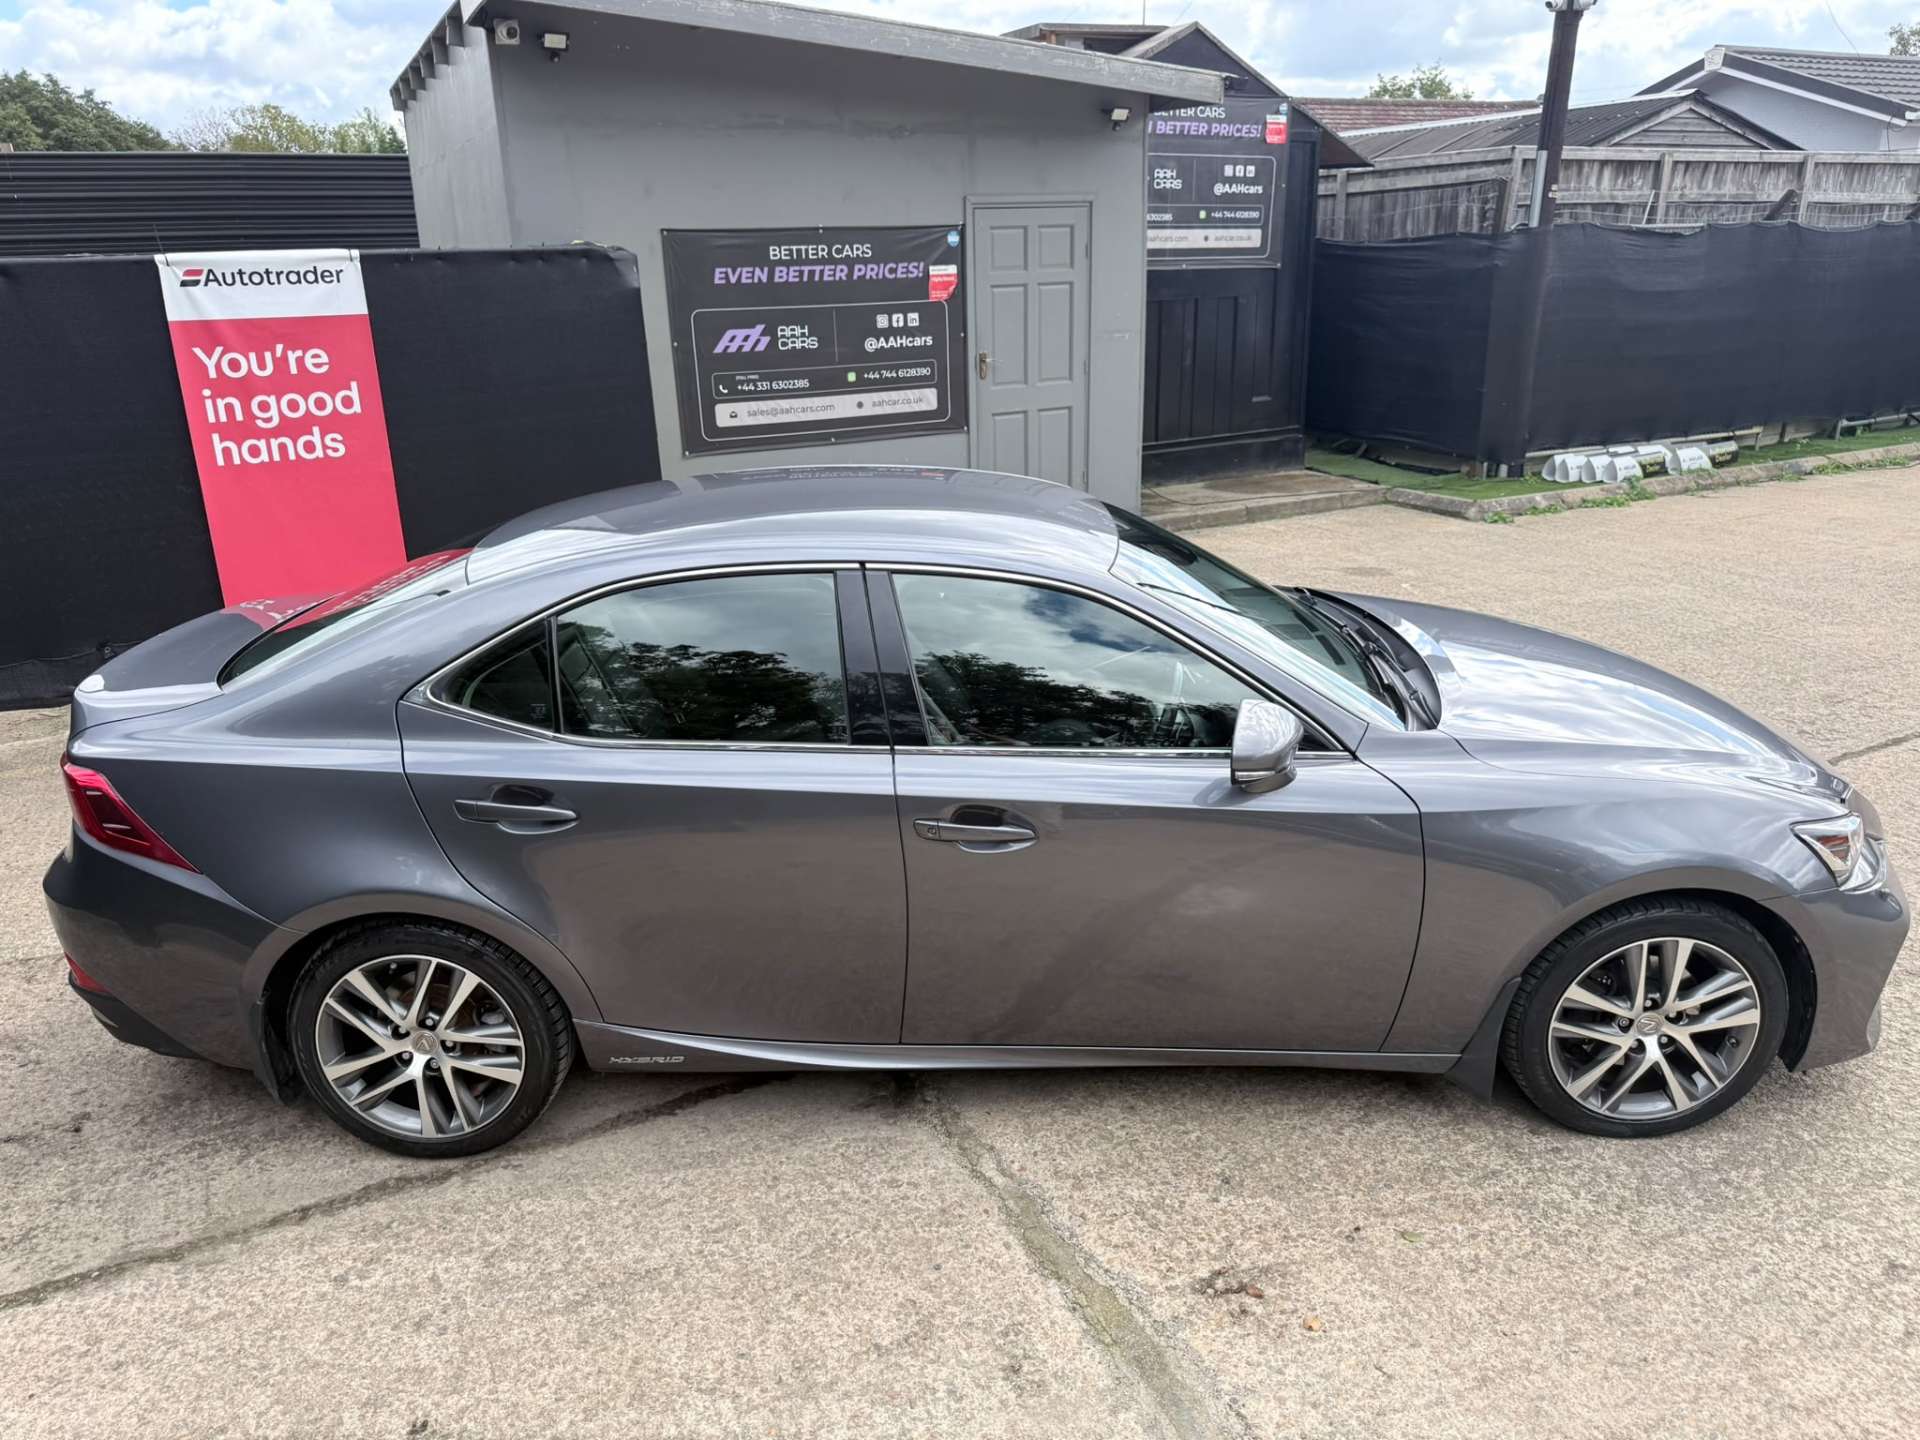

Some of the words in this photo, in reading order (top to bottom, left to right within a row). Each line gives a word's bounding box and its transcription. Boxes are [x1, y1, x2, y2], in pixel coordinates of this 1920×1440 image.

[1197, 105, 1226, 119] CARS
[1156, 120, 1209, 136] BETTER
[1210, 122, 1263, 138] PRICES!
[1154, 168, 1177, 179] AAH
[1213, 182, 1263, 196] @AAHcars
[769, 245, 829, 260] BETTER
[831, 243, 872, 259] CARS
[203, 265, 345, 288] Autotrader
[713, 266, 769, 284] EVEN
[774, 265, 848, 283] BETTER
[852, 261, 924, 281] PRICES!
[777, 325, 808, 338] AAH
[778, 337, 819, 350] CARS
[864, 335, 934, 352] @AAHcars
[191, 343, 330, 379] You're
[737, 382, 756, 392] +44
[756, 381, 771, 391] 331
[771, 379, 810, 390] 6302385
[201, 388, 244, 424] in
[250, 381, 362, 429] good
[746, 403, 836, 418] sales@aahcars.com
[211, 426, 347, 467] hands
